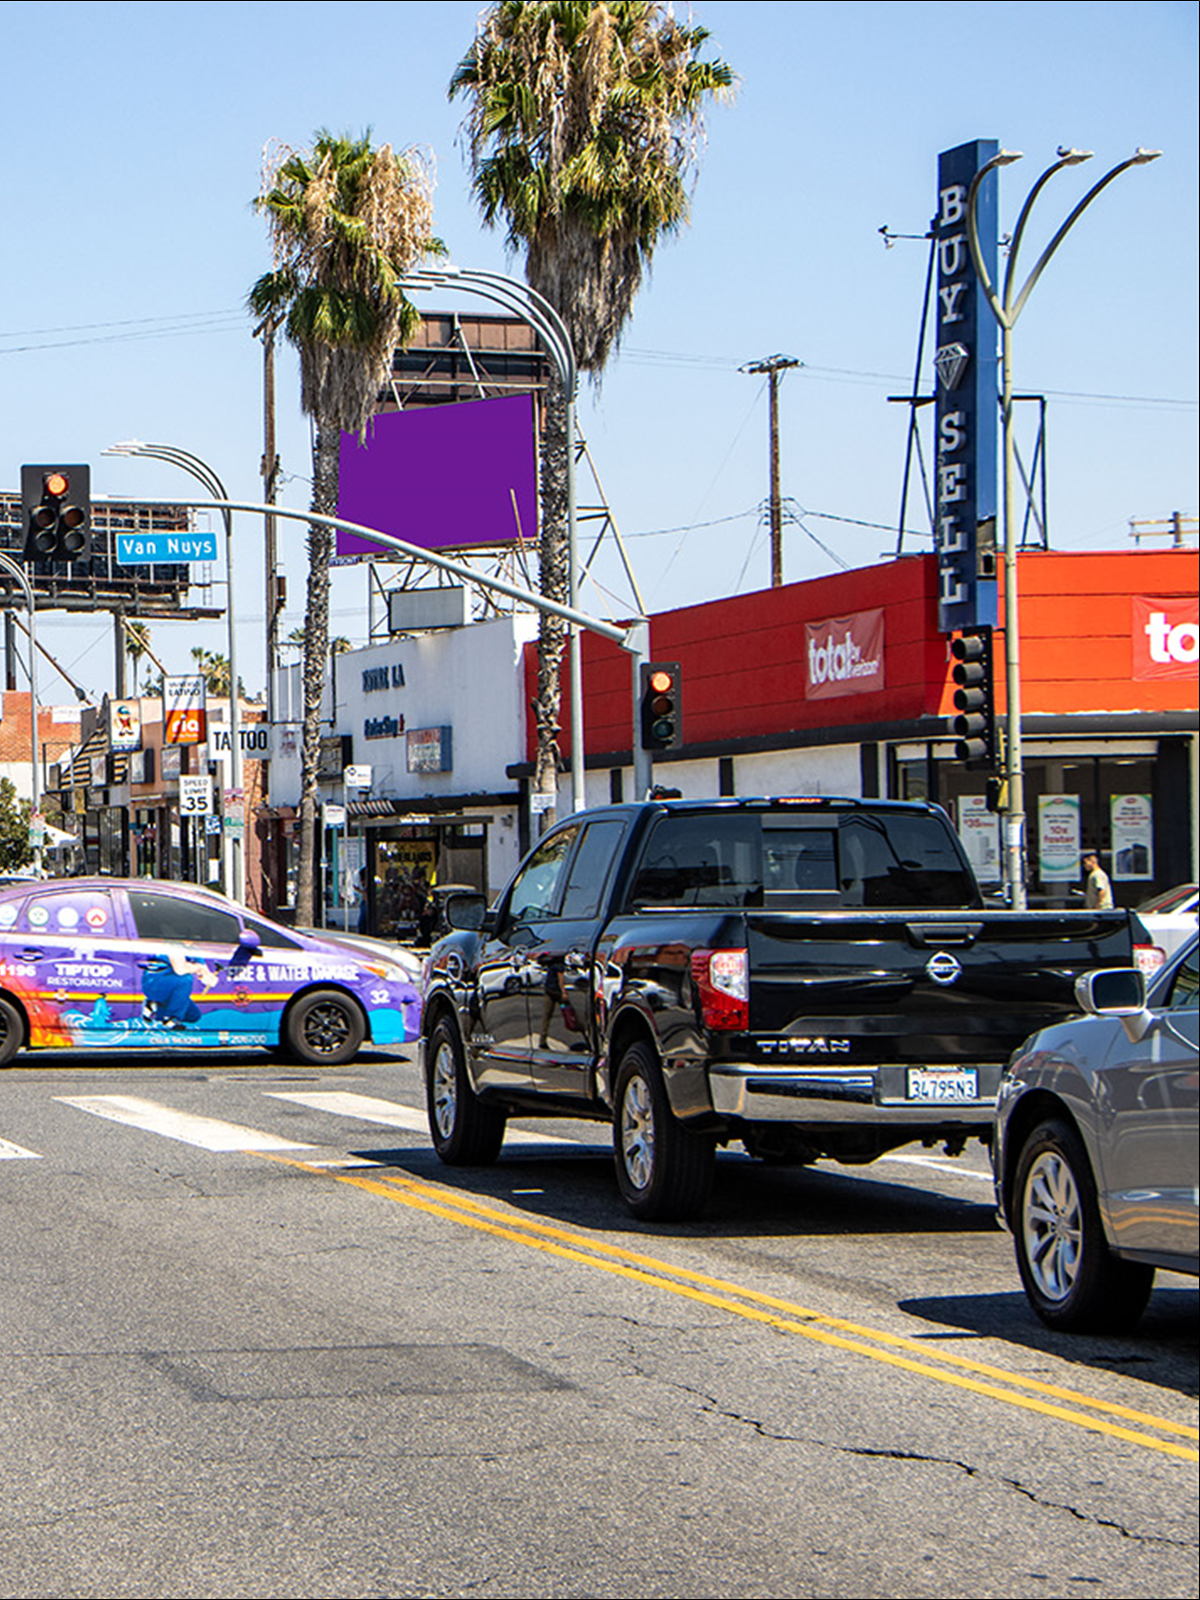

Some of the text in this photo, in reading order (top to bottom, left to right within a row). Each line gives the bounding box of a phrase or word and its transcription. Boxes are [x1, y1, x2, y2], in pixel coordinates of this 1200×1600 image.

[939, 183, 968, 324] BUY
[940, 410, 968, 606] SELL
[123, 538, 213, 558] Van Nuys
[1144, 612, 1200, 663] to
[808, 631, 852, 685] total
[171, 714, 200, 733] ria
[213, 730, 268, 751] TATOO
[183, 779, 209, 787] SPEED
[184, 787, 207, 795] LIMIT
[187, 796, 209, 811] 35
[54, 963, 115, 977] TIPTOP
[256, 966, 267, 981] &
[269, 966, 310, 982] WATER
[47, 976, 123, 988] RESTORATION
[370, 990, 391, 1004] 32
[756, 1038, 850, 1053] TITAN
